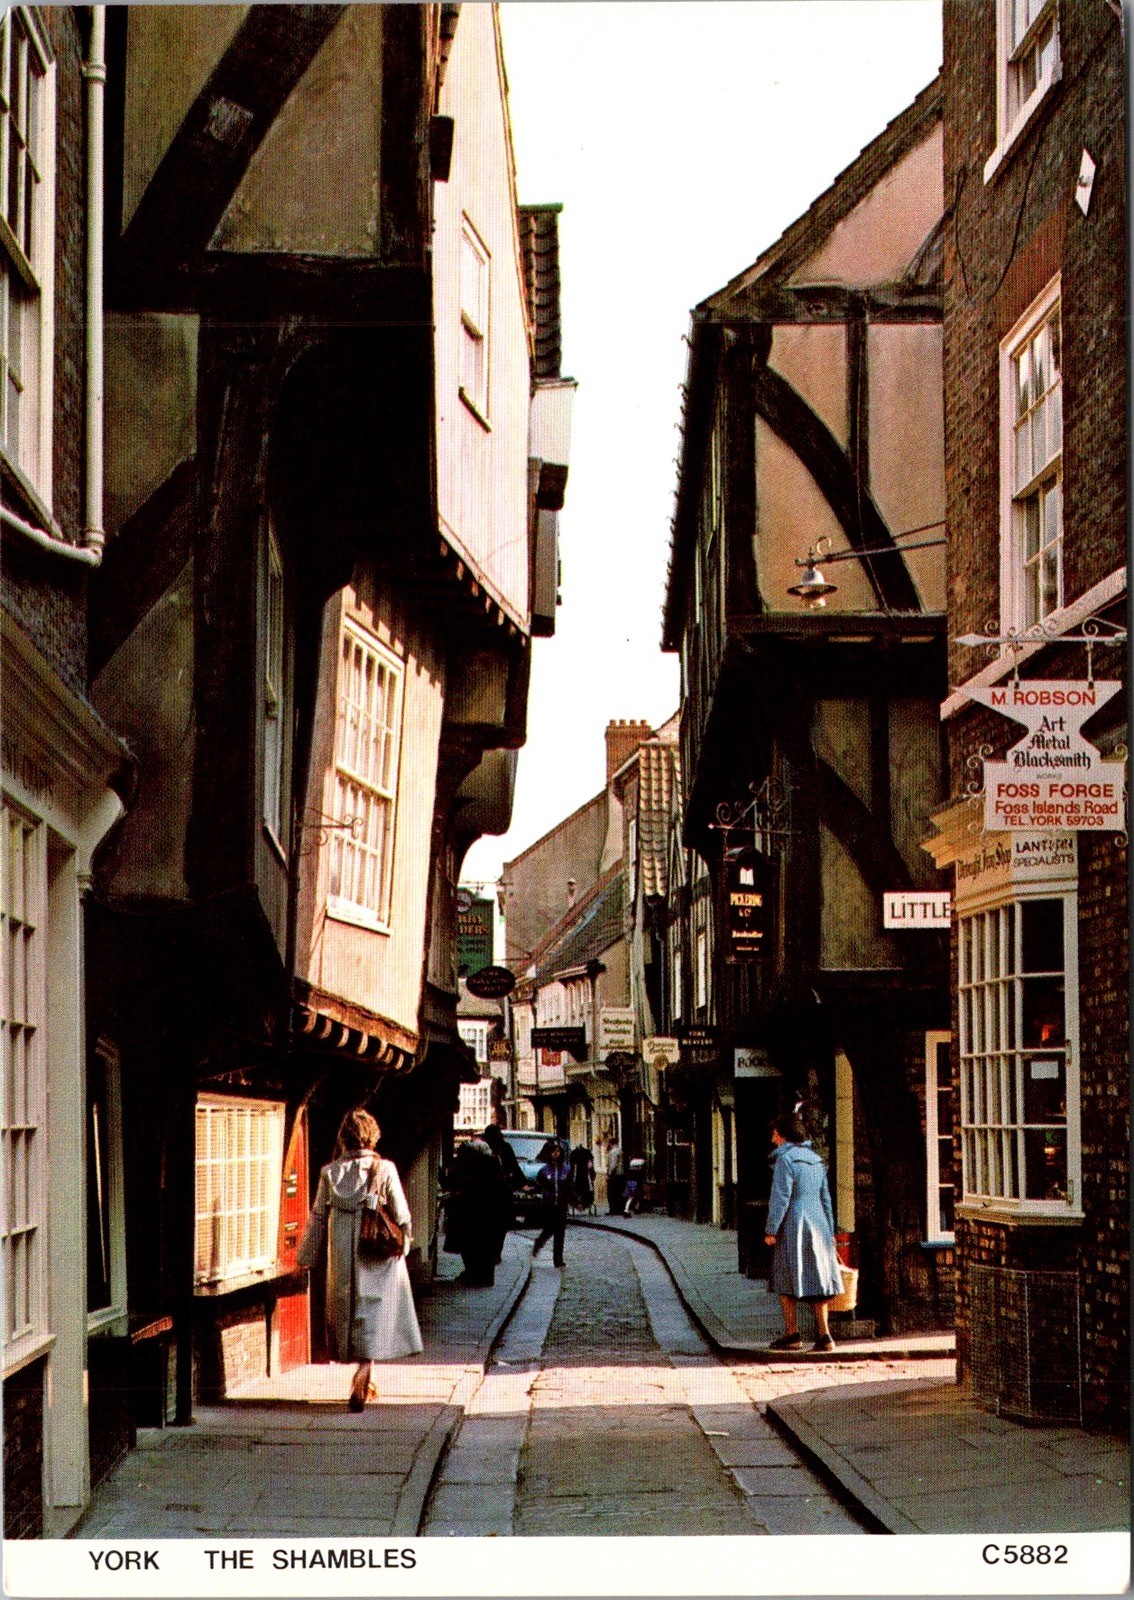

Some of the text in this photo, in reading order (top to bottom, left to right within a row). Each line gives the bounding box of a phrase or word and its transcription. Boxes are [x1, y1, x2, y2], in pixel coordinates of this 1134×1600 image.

[1013, 690, 1096, 706] ROBSON
[1037, 715, 1067, 733] Art
[1011, 750, 1092, 769] Blacksmith
[997, 783, 1114, 798] FOSS FORGE
[995, 800, 1118, 815] Foss Islands Road
[1030, 815, 1063, 826] YORK
[1066, 815, 1105, 827] 59703
[1014, 853, 1075, 868] SPECIALISTS
[730, 893, 762, 907] PICKERING
[891, 901, 952, 918] LITTLE
